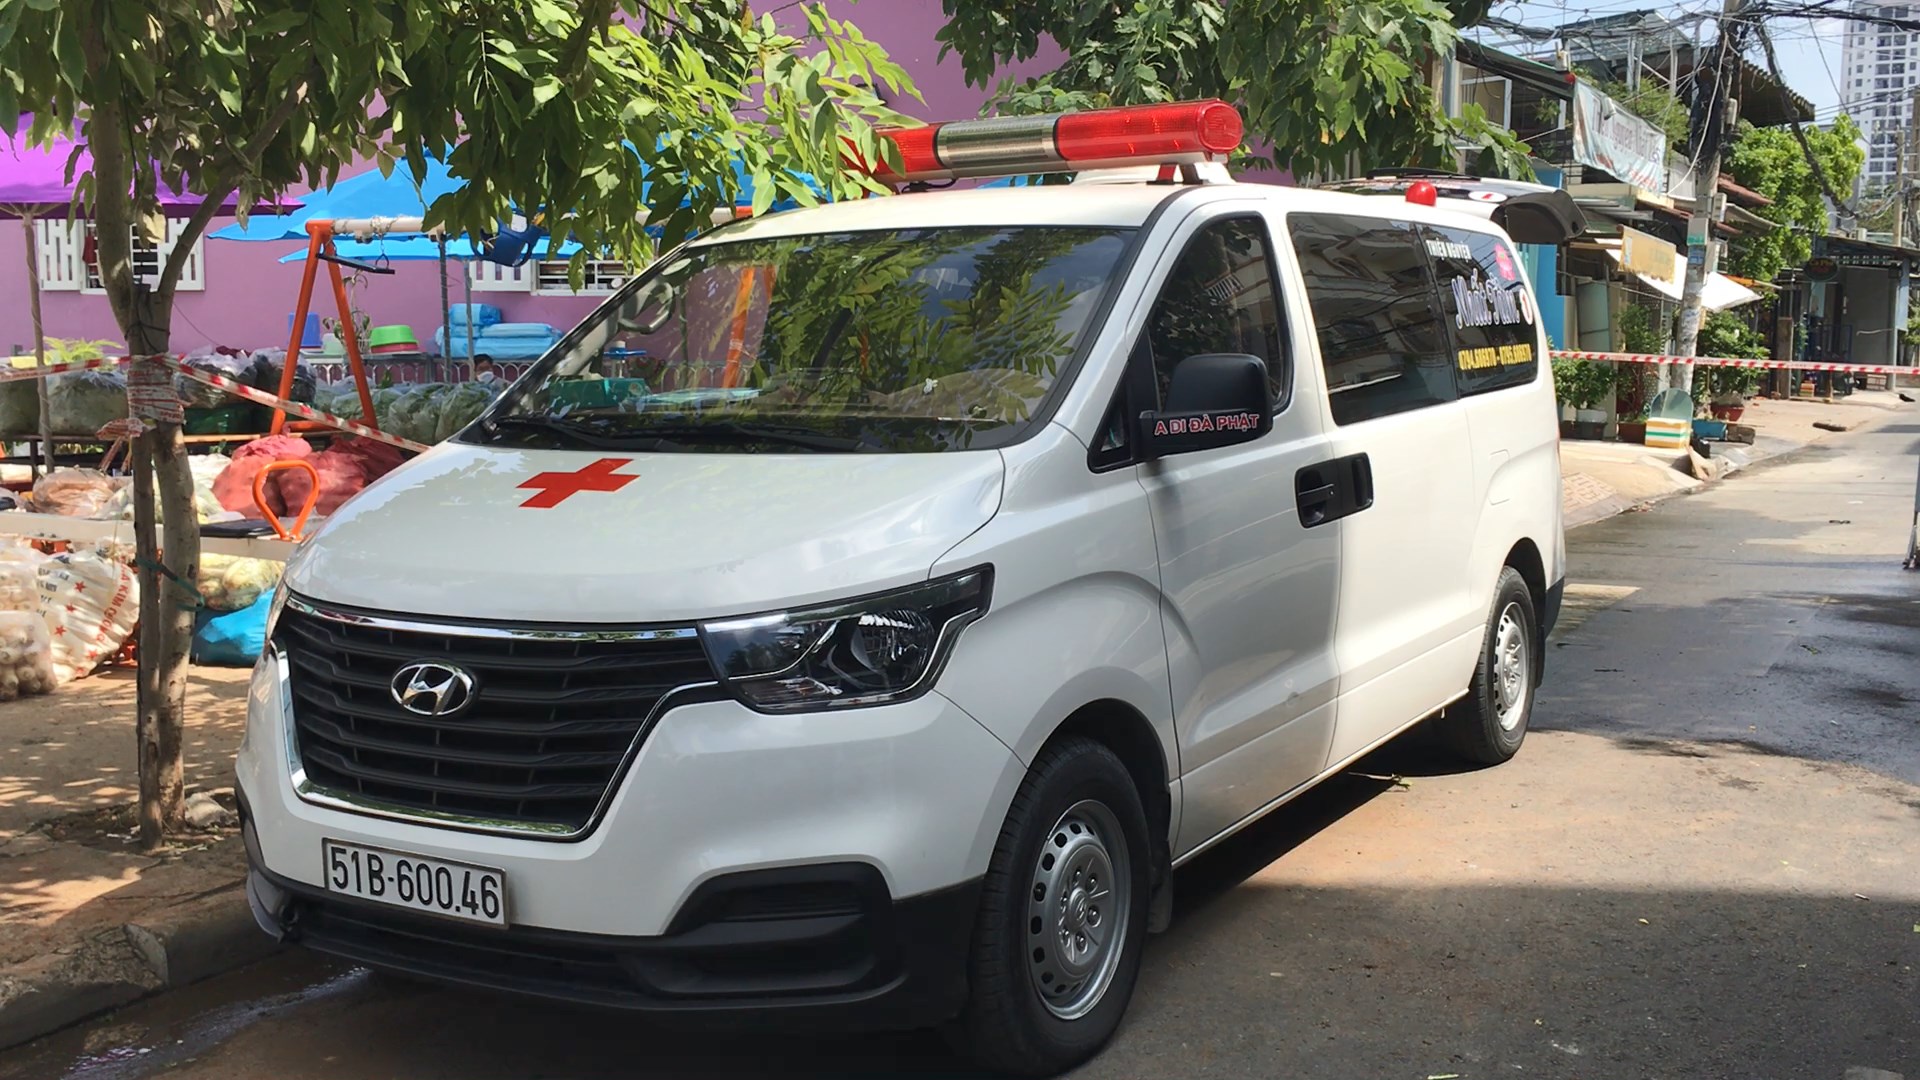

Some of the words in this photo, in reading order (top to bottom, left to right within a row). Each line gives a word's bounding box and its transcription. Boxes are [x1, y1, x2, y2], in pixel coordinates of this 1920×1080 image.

[1154, 420, 1169, 436] A
[1169, 418, 1187, 435] DI
[1189, 414, 1214, 432] ĐÀ
[1216, 413, 1260, 432] PHẬT
[330, 846, 500, 919] 51B-600.46
